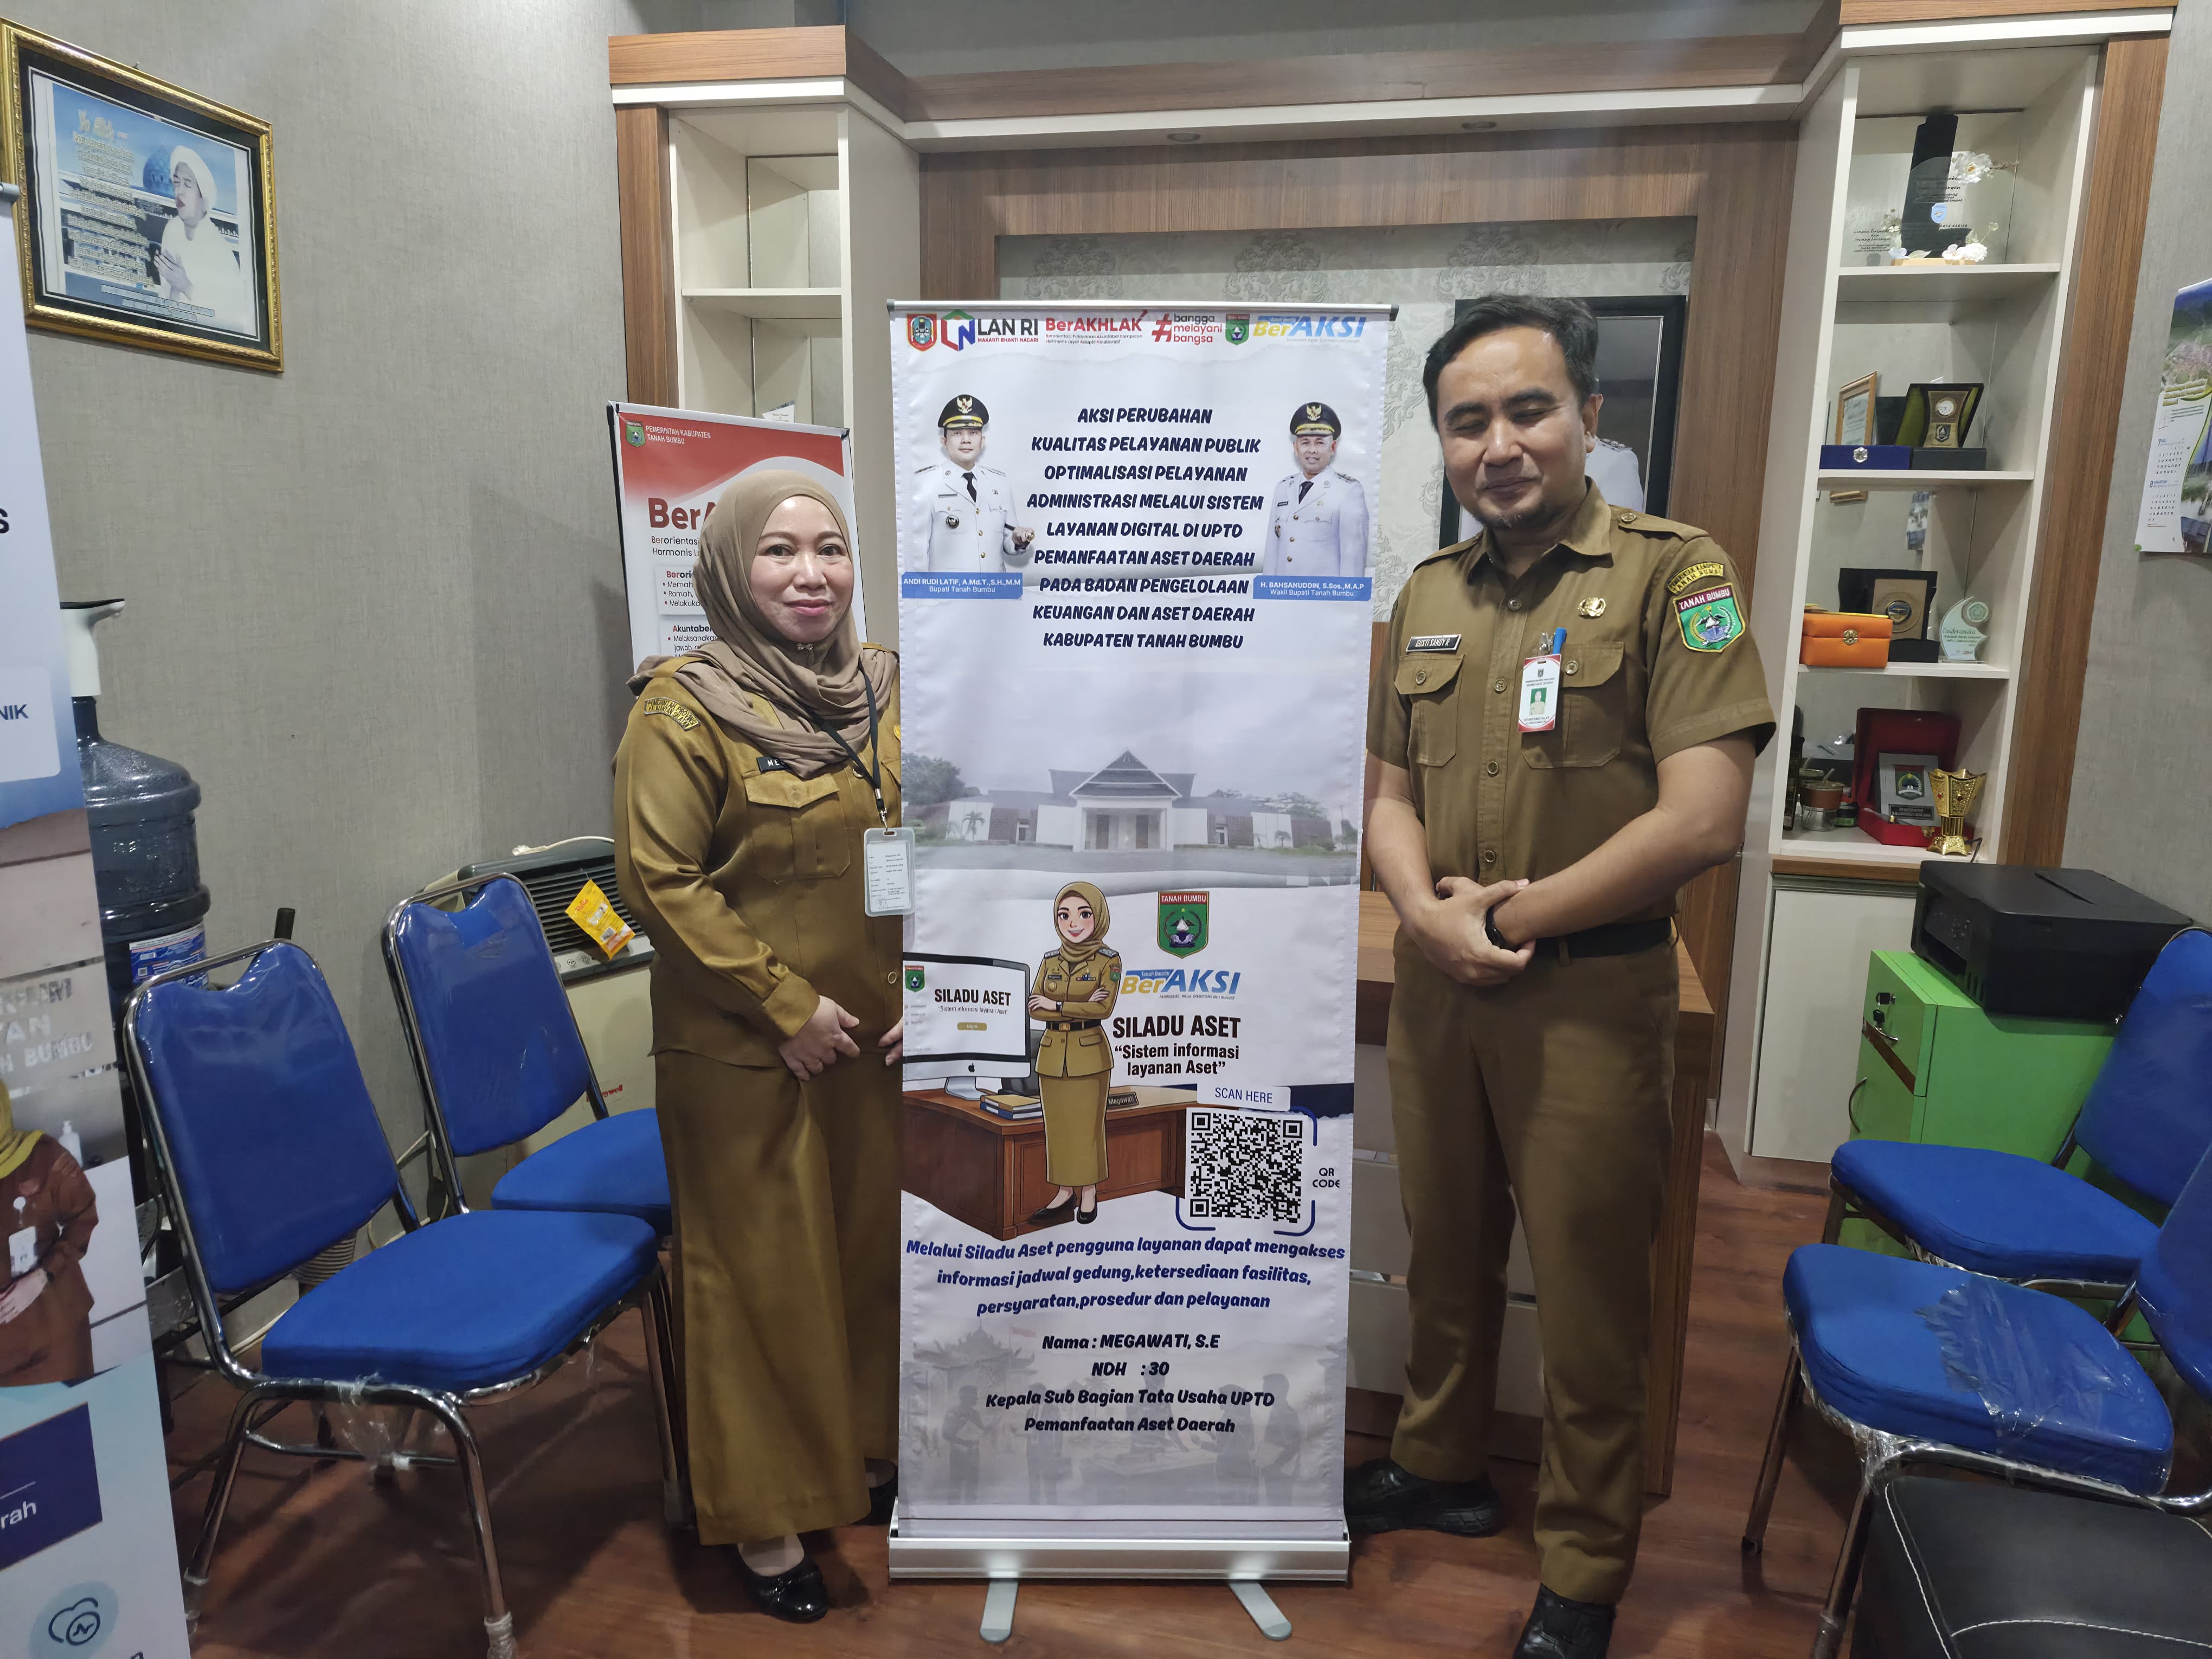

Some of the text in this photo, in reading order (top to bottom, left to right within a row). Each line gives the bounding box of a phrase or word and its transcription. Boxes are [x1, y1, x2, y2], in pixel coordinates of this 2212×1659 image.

[1046, 317, 1142, 332] BerAKHLAK
[1174, 313, 1215, 324] bangga
[978, 319, 1038, 336] LAN RI
[1174, 324, 1222, 333] melayani
[1253, 316, 1367, 338] BerAKSI
[1174, 335, 1213, 345] bangsa
[1077, 407, 1213, 424] AKSI PERUBAHAN
[646, 426, 711, 438] PEMERINTAH KABUPATEN
[1031, 436, 1261, 453] KUALITAS PELAYANAN PUBLIK
[1044, 466, 1248, 481] OPTIMALISASI PELAYANAN
[1027, 493, 1264, 510] ADMINISTRASI MELALUI SISTEM
[1046, 522, 1243, 538] LAYANAN DIGITAL DI UPTD
[652, 536, 699, 545] Berorientasi
[653, 548, 692, 556] Harmonis
[1034, 550, 1255, 566] PEMANFAATAN ASET DAERAH
[1039, 578, 1249, 594] PADA BADAN PENGELOLAAN
[1679, 589, 1729, 609] TANAH BUMBU
[1032, 606, 1255, 622] KEUANGAN DAN ASET DAERAH
[1043, 633, 1243, 649] KABUPATEN TANAH BUMBU
[1120, 969, 1240, 994] BerAKSI
[935, 989, 1011, 1006] SILADU ASET
[1113, 1015, 1240, 1038] SILADU ASET
[1173, 1043, 1239, 1059] informasi
[1127, 1061, 1181, 1078] layanan
[1214, 1087, 1272, 1103] SCAN HERE
[1319, 1168, 1334, 1177] QR
[1312, 1178, 1340, 1188] CODE
[906, 1237, 1345, 1259] Melalui Siladu Aset pengguna layanan dapat mengakses
[937, 1264, 1311, 1288] informasi jadwal gedung,ketersediaan fasilitas,
[977, 1291, 1270, 1317] persyaratan,prosedur dan pelayanan
[1042, 1334, 1220, 1350] Nama : MEGAWATI, S.E
[1092, 1362, 1169, 1376] NDH : 30
[986, 1388, 1275, 1409] Kepala Sub Bagian Tata Usaha UPTD
[1024, 1417, 1235, 1432] Pemanfaatan Aset Daerah
